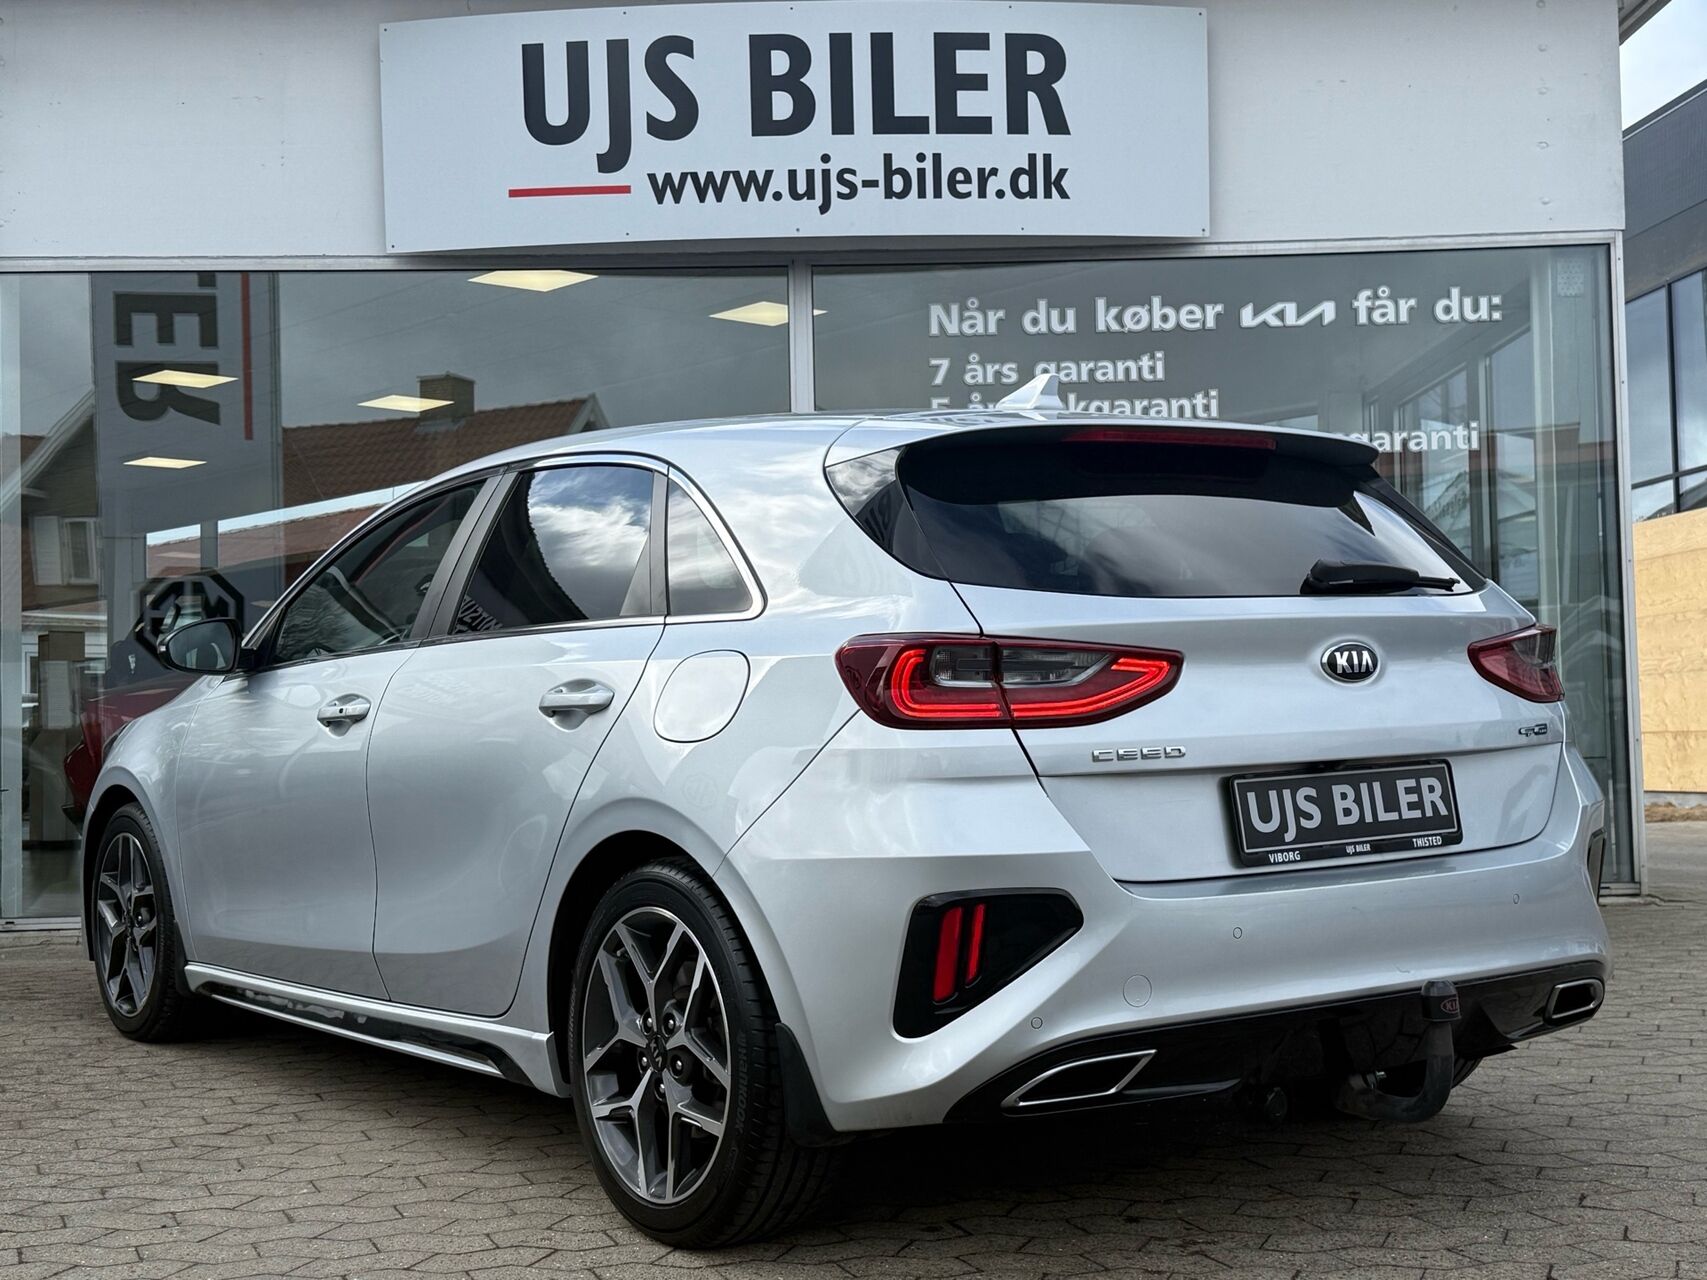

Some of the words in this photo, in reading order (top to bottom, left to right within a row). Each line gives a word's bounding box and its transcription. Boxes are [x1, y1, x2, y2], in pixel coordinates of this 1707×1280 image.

[521, 34, 700, 174] UJS
[748, 31, 1072, 137] BILER
[646, 151, 1072, 216] www.ujs-biler.dk
[928, 297, 1005, 337] Når
[1021, 298, 1077, 335] du
[1095, 295, 1225, 333] køber
[1239, 300, 1337, 328] KIA
[1352, 285, 1417, 326] får
[1433, 286, 1503, 324] du:
[928, 357, 950, 386] 7
[963, 352, 1019, 385] års
[1333, 650, 1375, 674] KIA
[1092, 745, 1187, 763] CEED
[1246, 786, 1323, 843] UJS
[1331, 776, 1449, 826] BILER
[1268, 850, 1301, 864] VIBORG
[1356, 843, 1371, 852] BILER
[1412, 835, 1443, 848] THISTED
